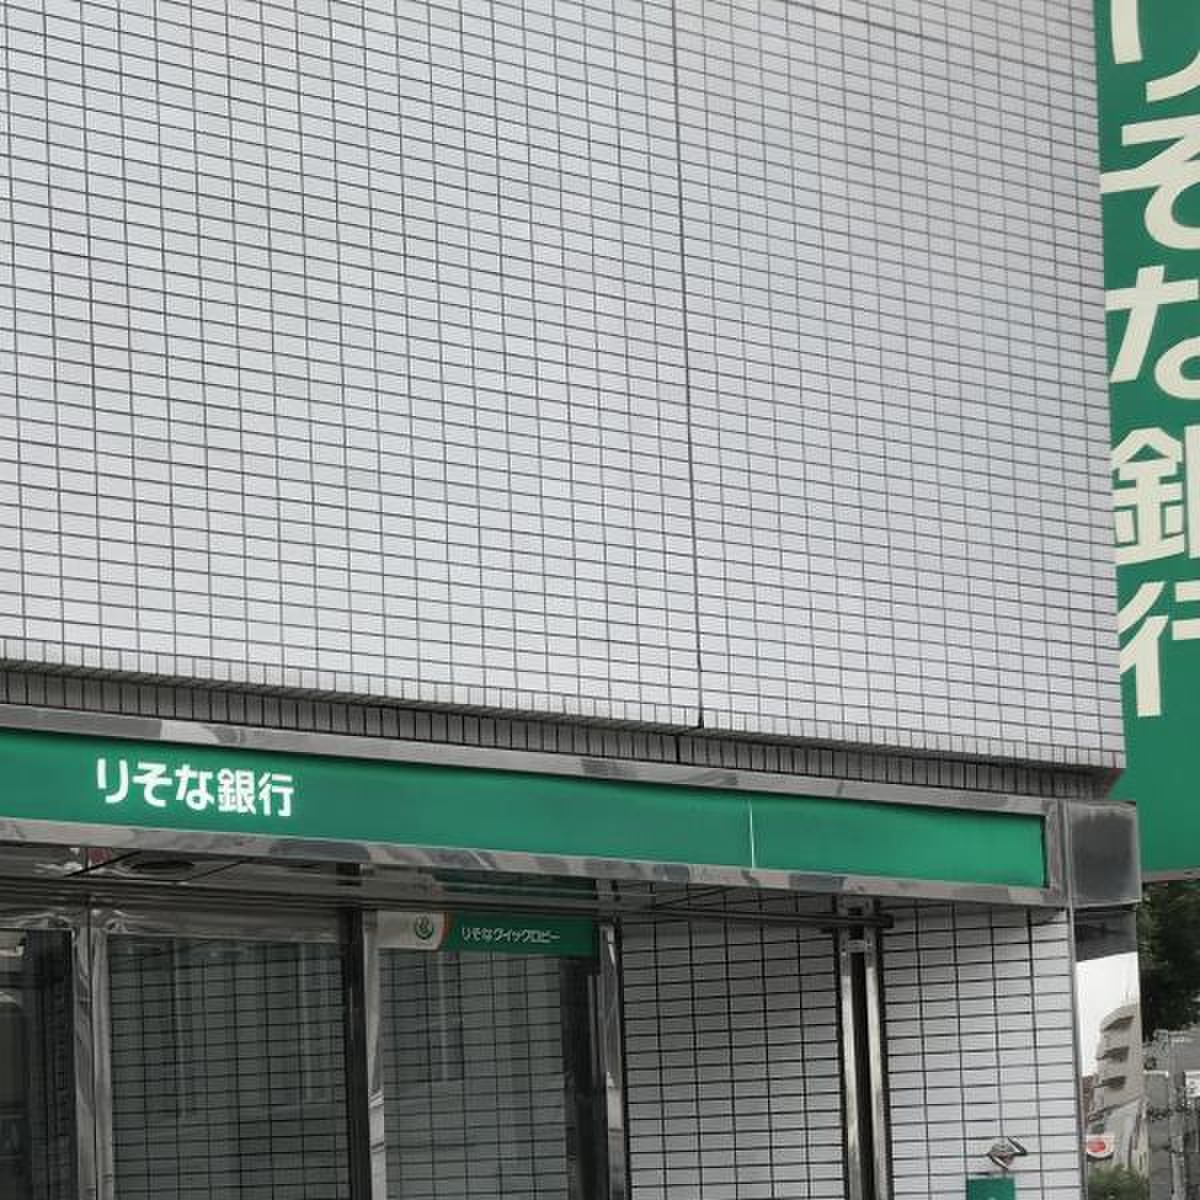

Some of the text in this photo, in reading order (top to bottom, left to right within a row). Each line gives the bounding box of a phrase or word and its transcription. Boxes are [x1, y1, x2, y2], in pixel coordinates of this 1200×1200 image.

[96, 758, 294, 817] りそな銀行
[461, 926, 560, 944] りそなクイックロビー
